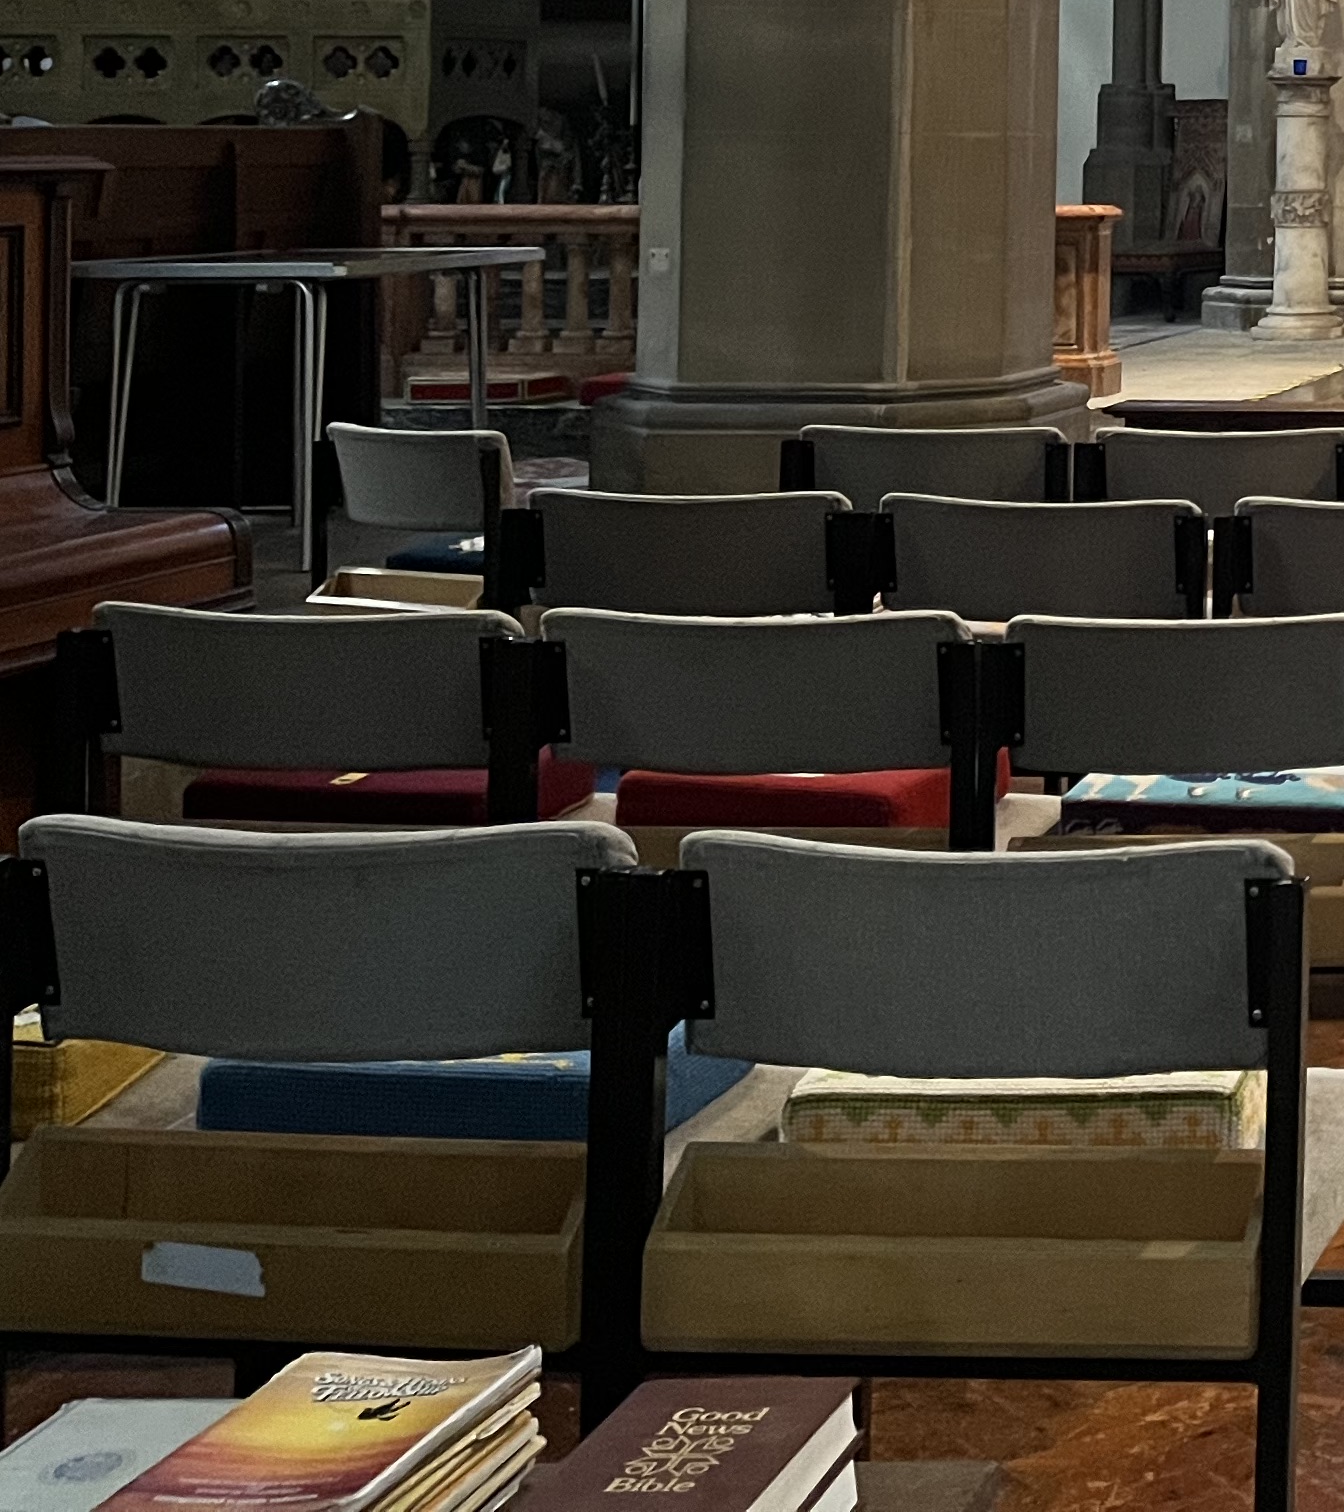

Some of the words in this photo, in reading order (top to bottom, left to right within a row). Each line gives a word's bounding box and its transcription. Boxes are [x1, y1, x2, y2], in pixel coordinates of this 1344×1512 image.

[671, 1407, 770, 1422] Good
[655, 1421, 753, 1435] News
[603, 1477, 696, 1493] Bible
